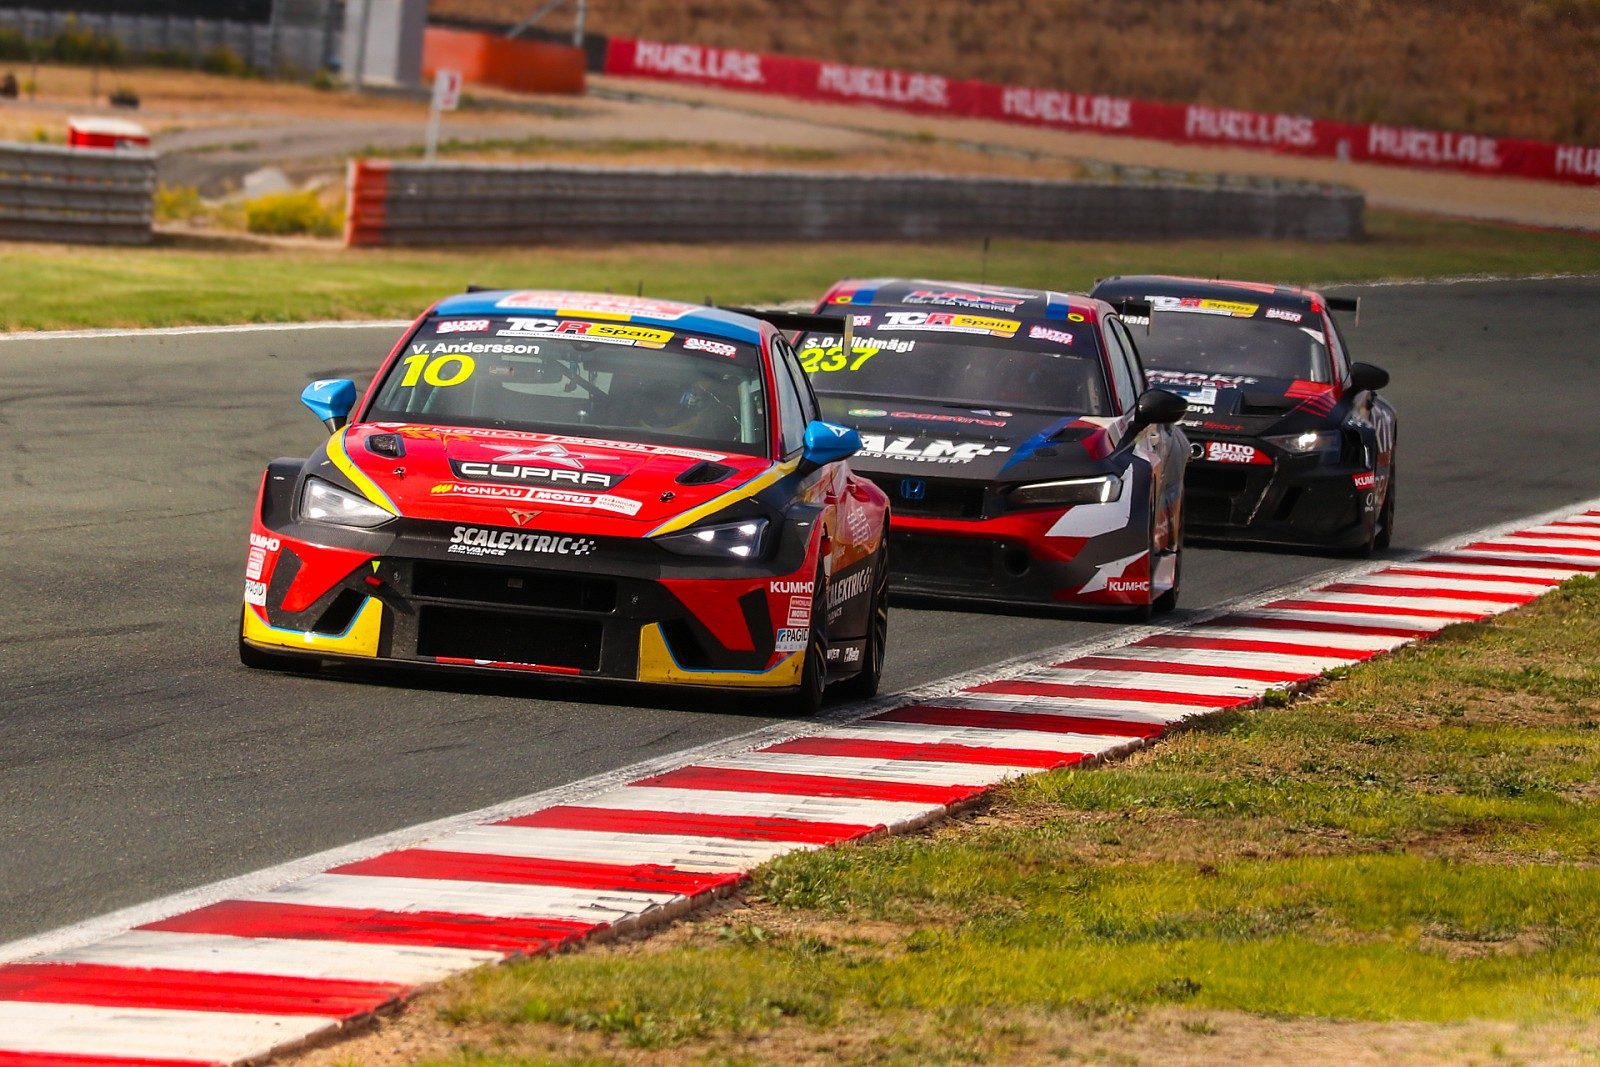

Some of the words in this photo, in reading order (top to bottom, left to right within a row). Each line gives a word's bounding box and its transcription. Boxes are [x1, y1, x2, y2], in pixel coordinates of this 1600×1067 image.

[438, 320, 490, 328] AUTO
[885, 311, 954, 327] TCR
[960, 317, 1012, 329] Spain
[436, 325, 489, 334] SPORT
[506, 317, 592, 335] TCR
[598, 326, 661, 339] Spain
[1030, 325, 1073, 340] AUTO
[685, 337, 736, 352] AUTO
[1029, 333, 1071, 346] SPORT
[412, 344, 430, 355] V.
[433, 342, 540, 355] Andersson
[683, 343, 736, 357] SPORT
[800, 347, 880, 373] 237
[401, 353, 476, 387] 10
[433, 427, 538, 439] MONLAU
[1209, 441, 1255, 456] AUTO
[1208, 452, 1254, 464] SPORT
[460, 462, 611, 488] CUPRA
[453, 485, 522, 497] MONLAU
[536, 490, 593, 504] MOTUL
[450, 526, 574, 555] SCALEXTRIC
[448, 544, 507, 556] ADVANCE
[770, 581, 814, 593] KUMHO
[1108, 580, 1150, 592] KUMHO
[786, 628, 809, 642] PAGID
